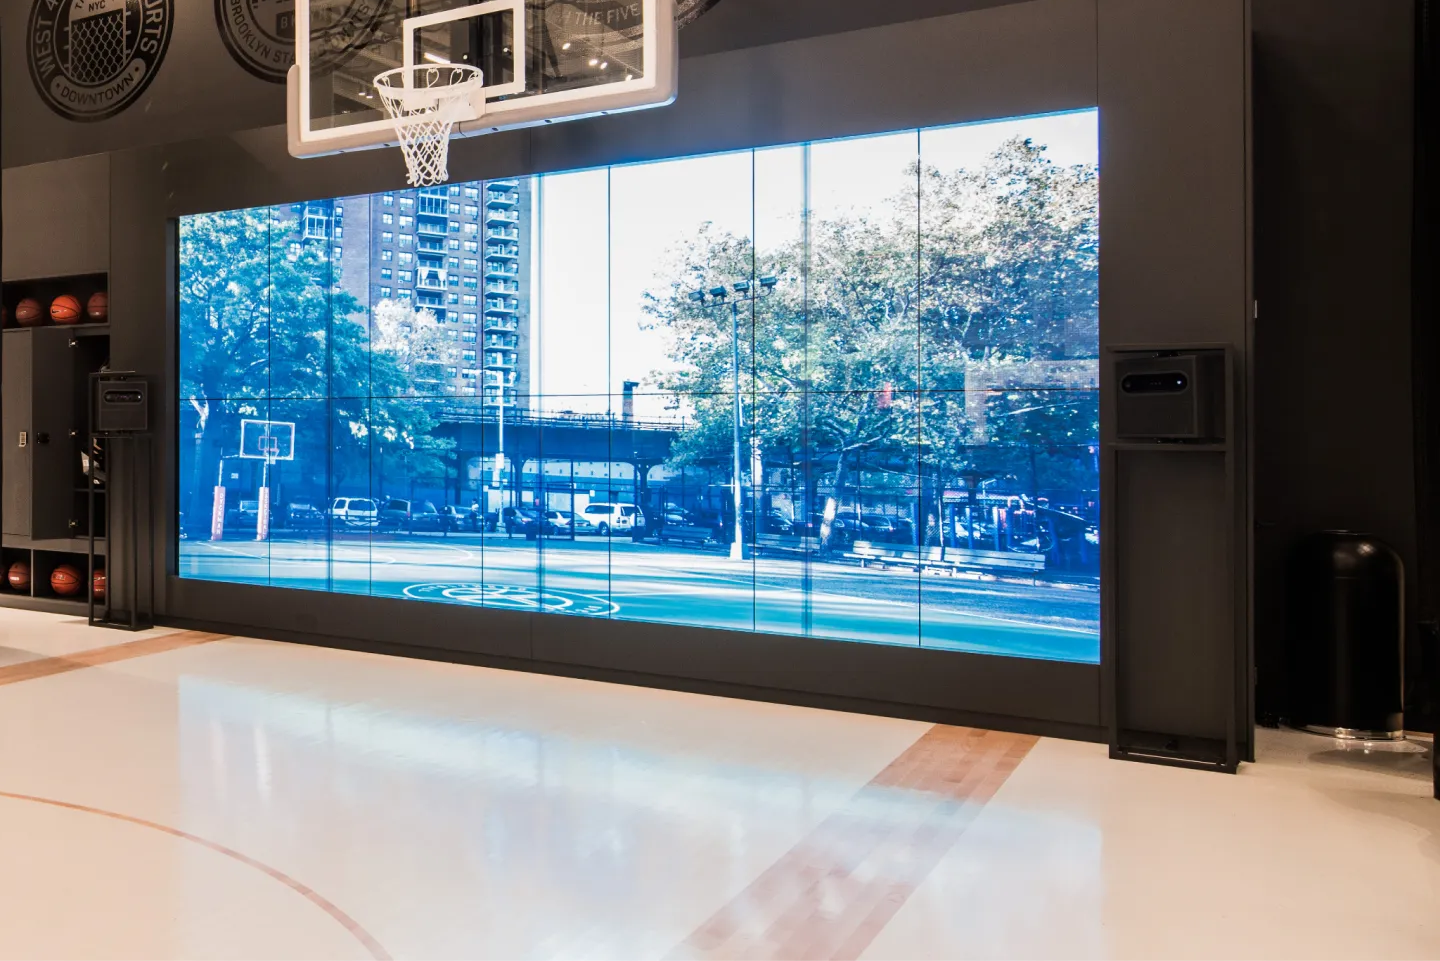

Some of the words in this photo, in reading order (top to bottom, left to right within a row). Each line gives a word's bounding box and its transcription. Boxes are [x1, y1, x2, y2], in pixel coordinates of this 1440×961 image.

[88, 0, 106, 12] NYC
[574, 11, 603, 26] THE
[606, 2, 642, 25] FIVE
[35, 15, 57, 78] WEST
[60, 72, 135, 106] DOWNTOWN
